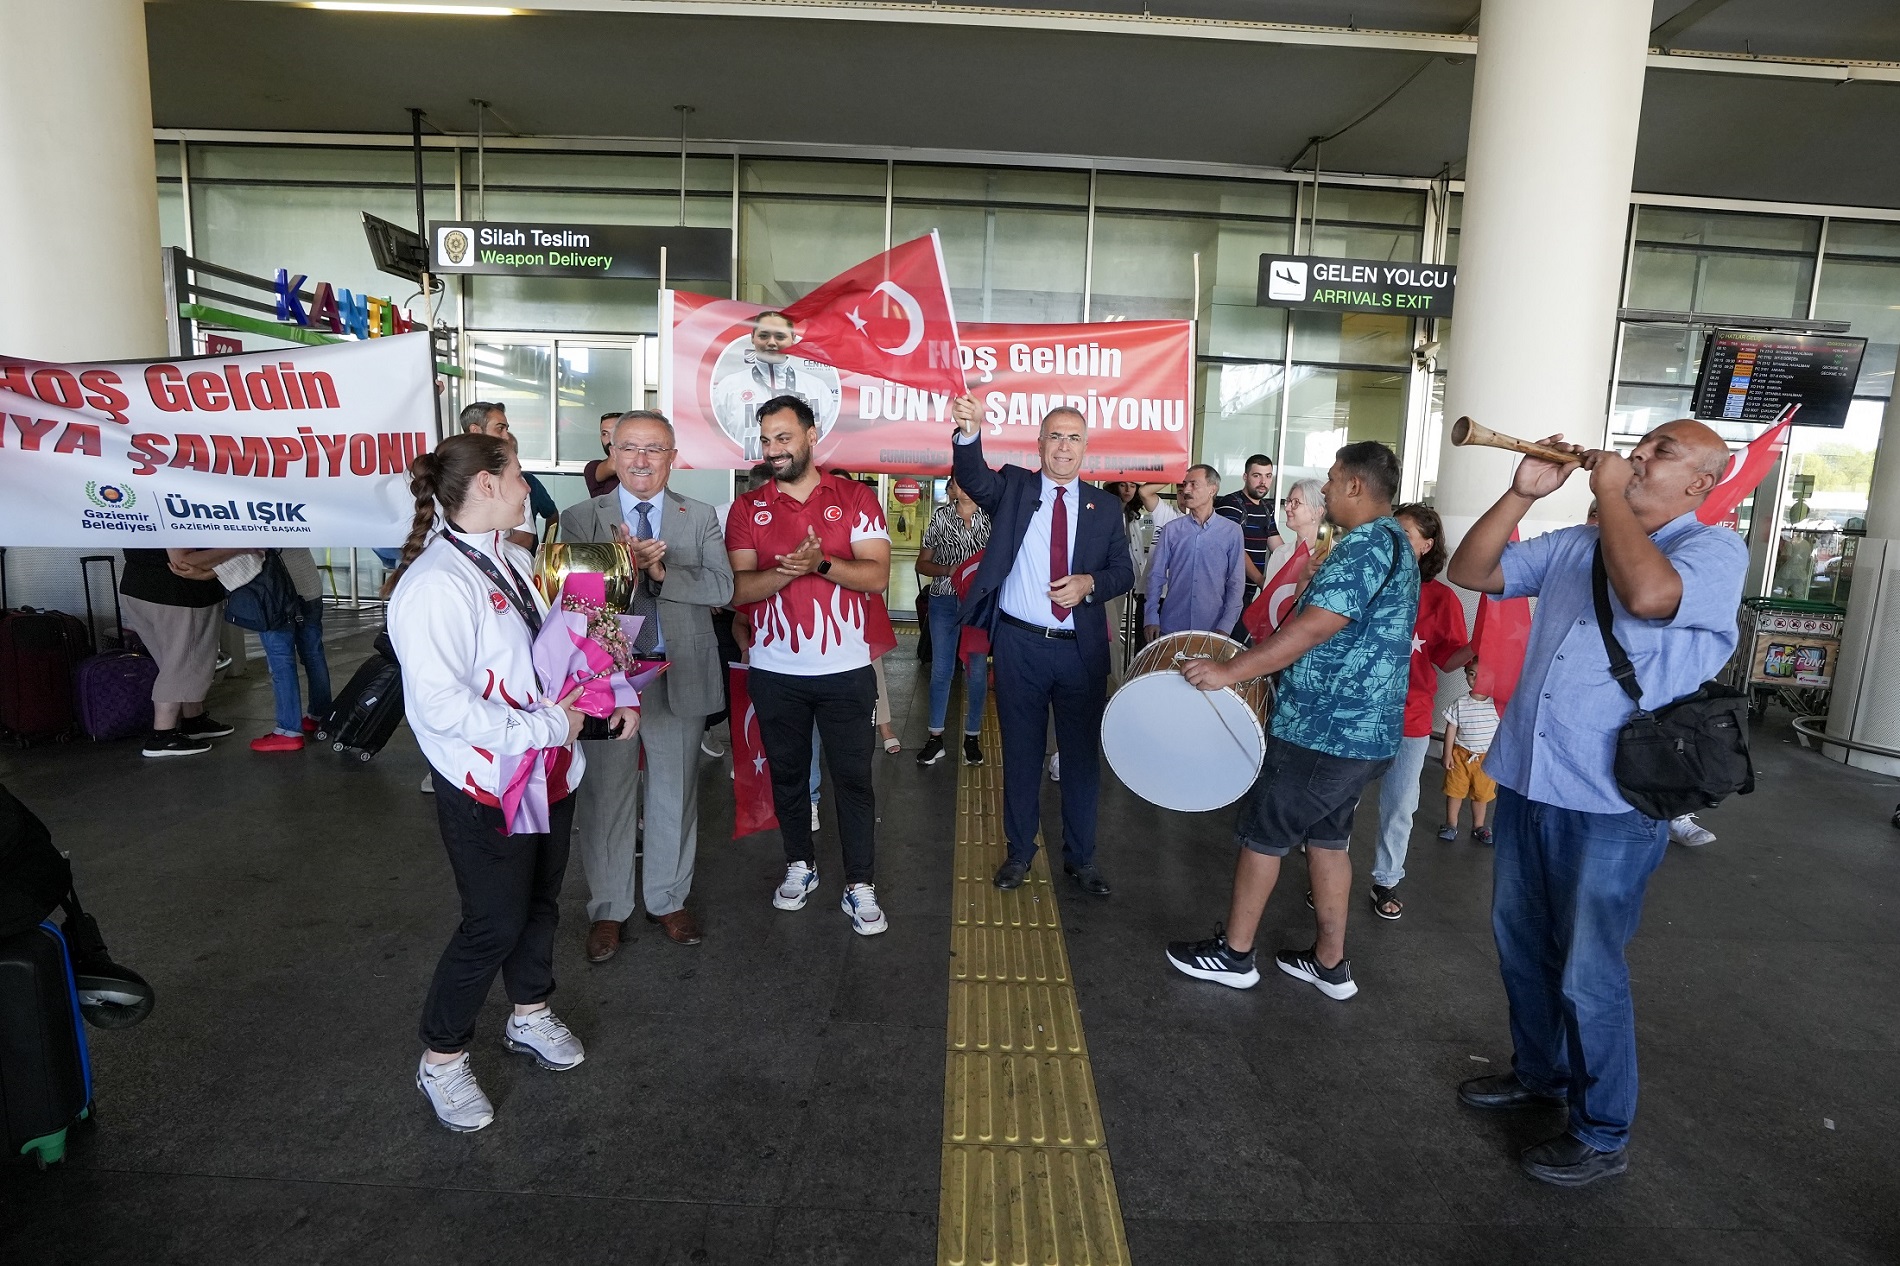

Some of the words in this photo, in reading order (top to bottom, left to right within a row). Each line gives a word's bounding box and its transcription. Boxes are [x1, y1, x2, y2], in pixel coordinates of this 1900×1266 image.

[480, 228, 525, 246] Silah
[530, 229, 590, 248] Teslim
[480, 250, 544, 267] Weapon
[549, 251, 613, 271] Delivery
[1313, 263, 1377, 284] GELEN
[1383, 267, 1448, 289] YOLCU
[1312, 289, 1392, 307] ARRIVALS
[1396, 294, 1433, 310] EXIT
[928, 340, 997, 382] Hoş
[1009, 343, 1122, 379] Geldin
[144, 362, 341, 412] Geldin
[0, 411, 101, 457] YA
[126, 426, 427, 478] ŞAMPİYONU
[84, 509, 150, 522] Gaziemir
[164, 493, 240, 520] Ünal
[246, 501, 308, 525] IŞIK
[82, 519, 157, 533] Belediyesi
[170, 521, 221, 531] GAZİEMİR
[223, 523, 271, 532] BELEDİYE
[271, 525, 312, 534] BAŞKANI
[1765, 654, 1797, 665] HAVE
[1797, 657, 1826, 668] FUN!
